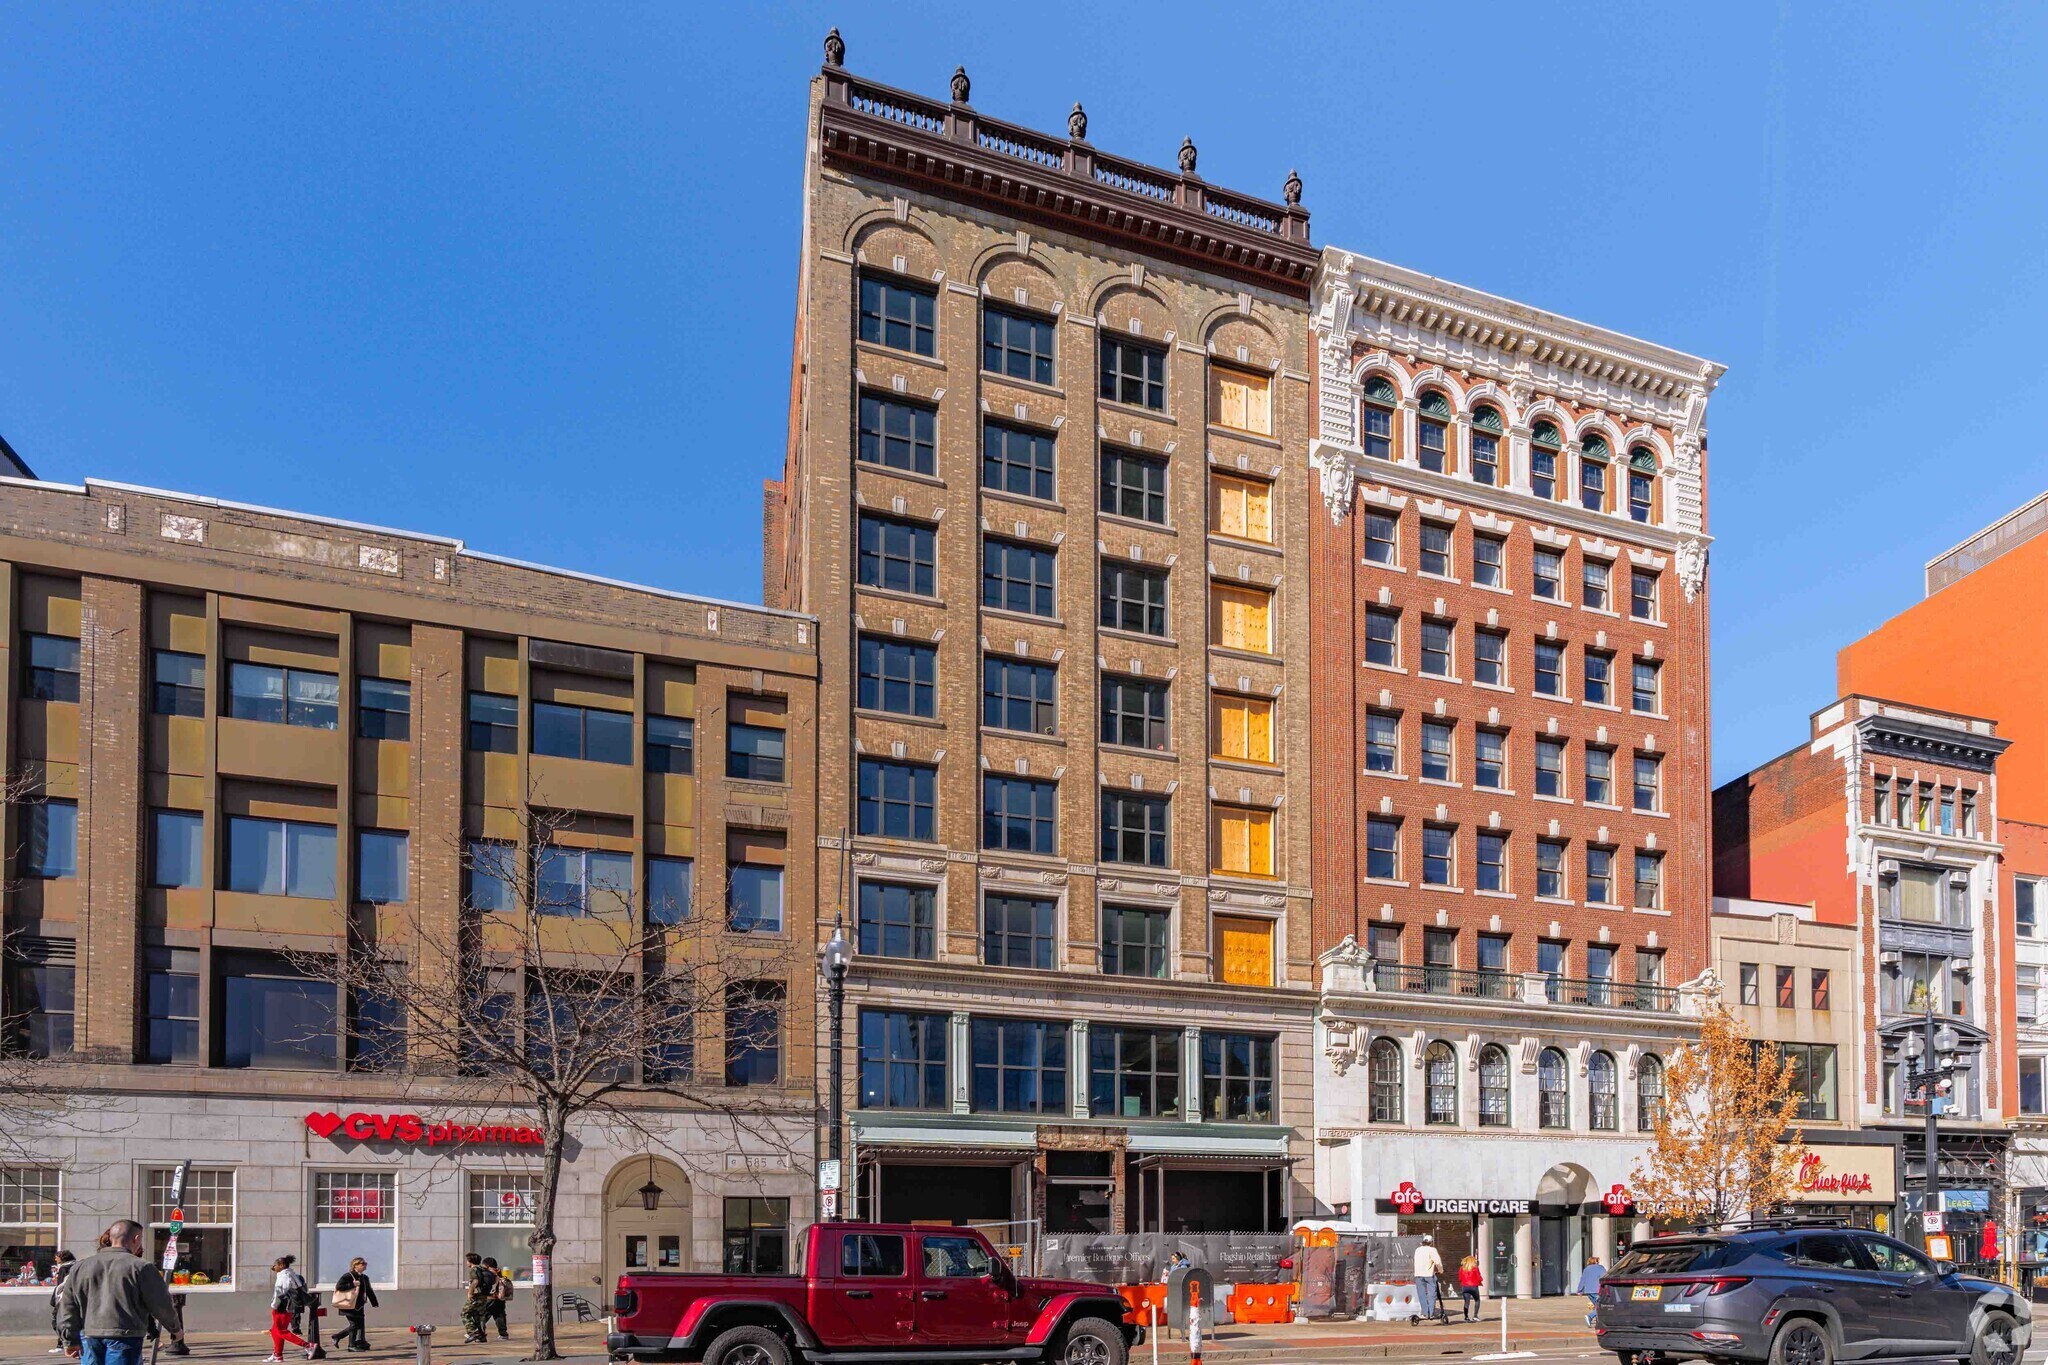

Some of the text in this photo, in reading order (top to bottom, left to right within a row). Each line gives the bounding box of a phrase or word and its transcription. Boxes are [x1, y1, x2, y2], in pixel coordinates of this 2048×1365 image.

[902, 983, 1238, 1017] WESLEYAN BUILDING
[344, 1112, 546, 1146] CVS pharmac
[747, 1157, 767, 1168] 585
[334, 1195, 359, 1203] open
[1395, 1187, 1530, 1214] afc URGENT CARE
[1947, 1200, 1972, 1208] LEASE
[334, 1206, 377, 1214] 24 hours
[1783, 1206, 1795, 1214] 569
[1063, 1252, 1151, 1264] Premier Boutique Offices
[1219, 1252, 1246, 1264] Flagship
[1246, 1252, 1265, 1262] Retail
